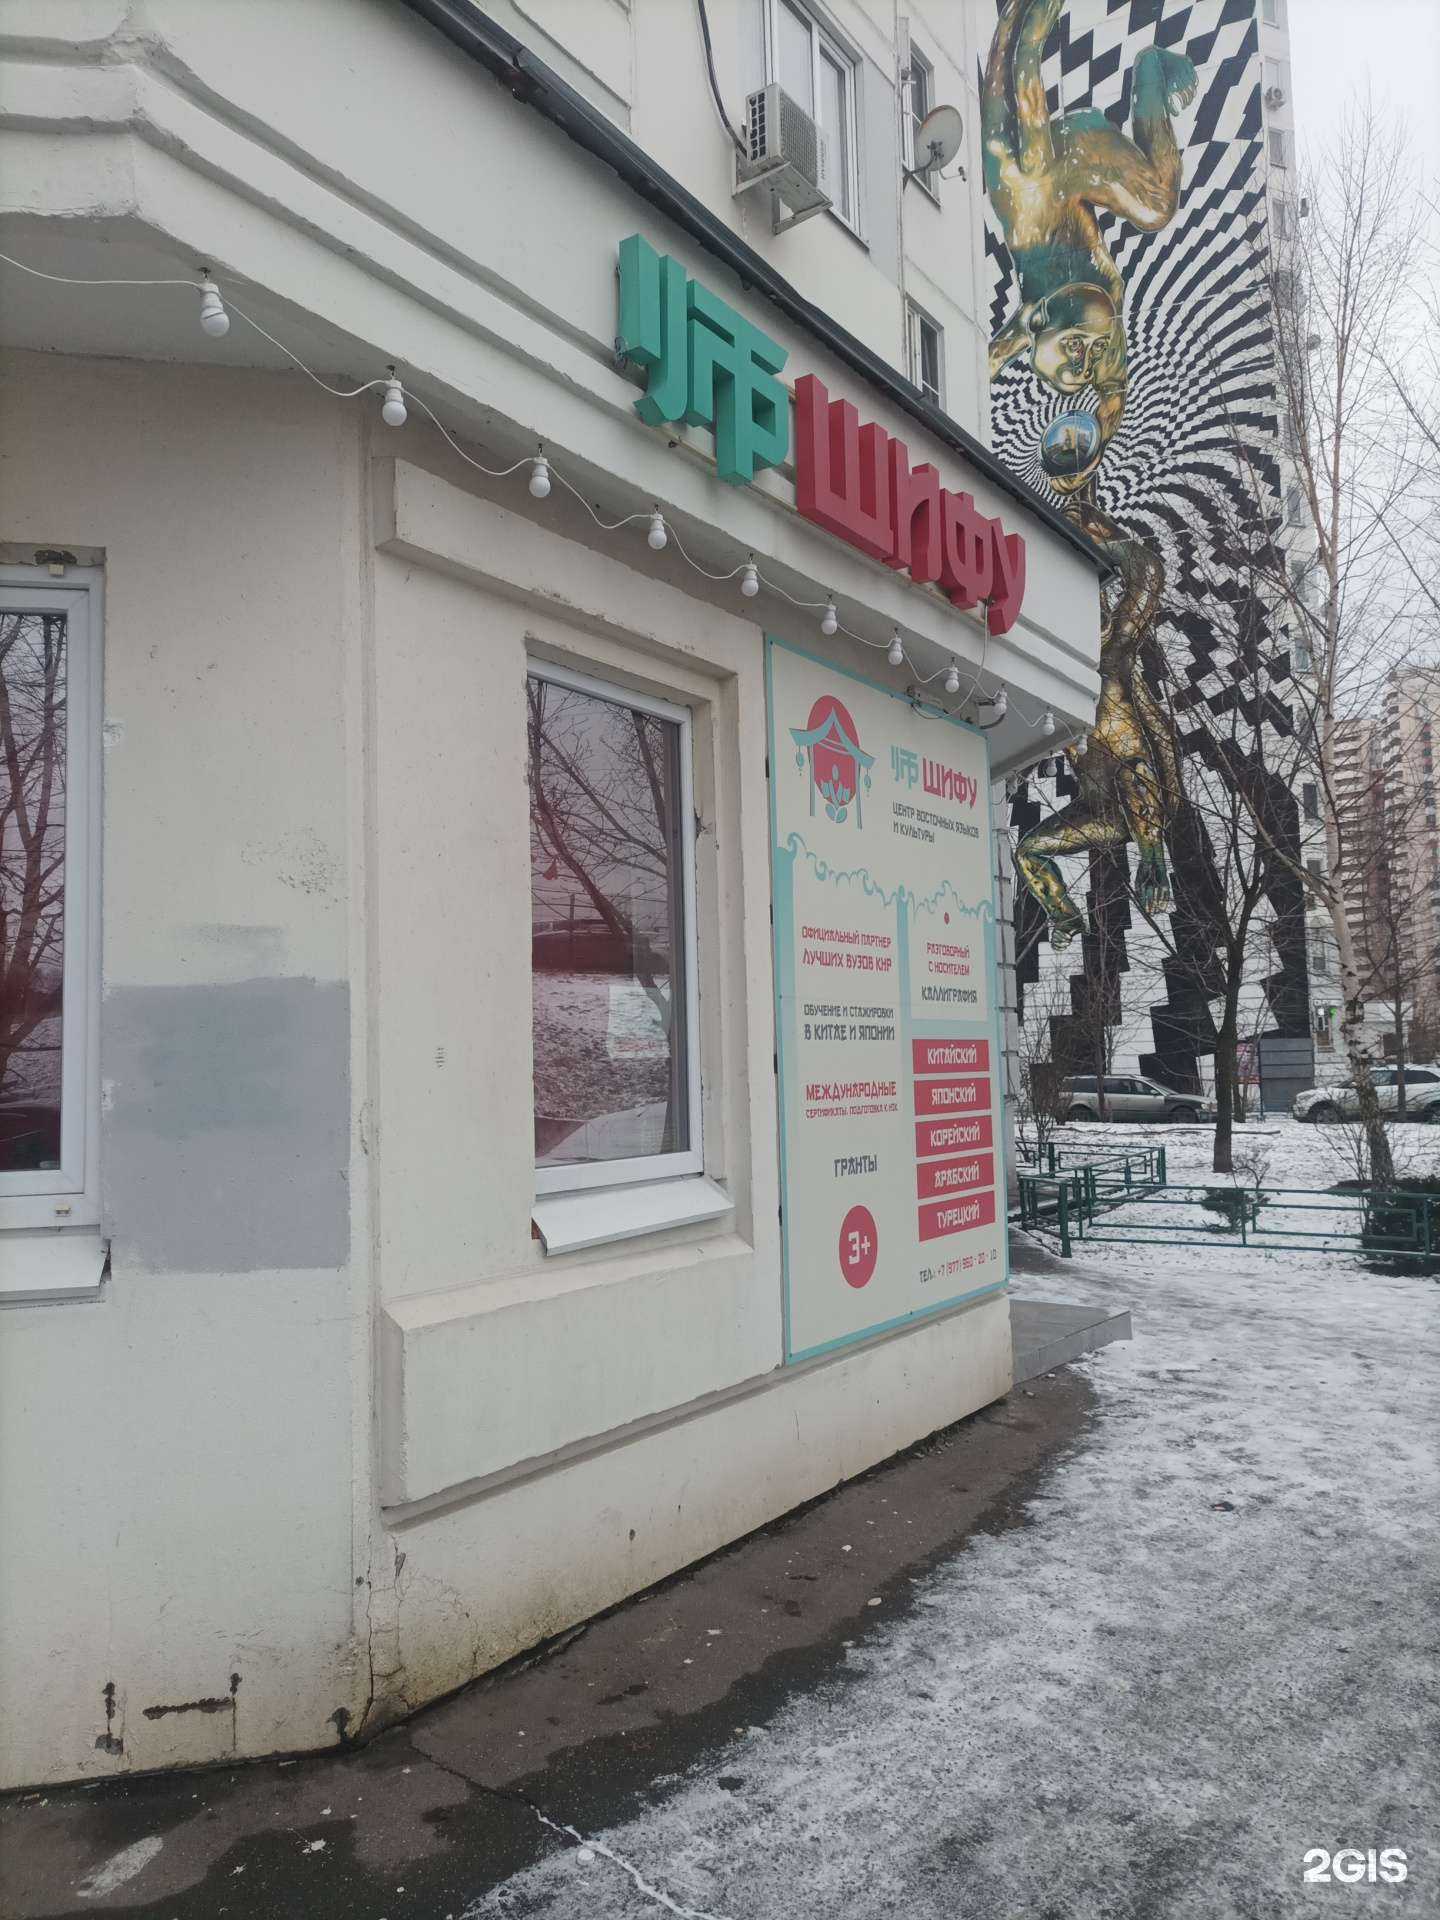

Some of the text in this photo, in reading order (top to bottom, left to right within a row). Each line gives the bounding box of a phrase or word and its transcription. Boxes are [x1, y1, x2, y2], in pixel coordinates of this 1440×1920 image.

[795, 373, 1026, 636] ШИФУ
[923, 757, 977, 809] ШИФУ
[892, 801, 979, 839] ЦЕНТР ВОСТОЧНЫХ ЯЗЫКОВ
[893, 820, 935, 843] И КУЛЬТУРЫ
[802, 925, 892, 949] ОФИЦИАЛЬНЫЙ ПАРТНЕР
[803, 948, 892, 972] ЛУЧШИХ ВУЗОВ КНР
[926, 942, 970, 959] РАЗГОВОРНЫЙ
[928, 961, 970, 977] С НОСИТЕЛЕМ
[921, 985, 978, 1004] КАЛЛИГРАФИЯ
[804, 1004, 894, 1019] ОБУЧЕНИЕ И СТАЖИРОВКИ
[804, 1023, 895, 1041] В КИТАЕ И ЯПОНИИ
[927, 1043, 977, 1065] КИТАЙСКИЙ
[806, 1080, 897, 1102] МЕЖДУНАРОДНЫЕ
[931, 1082, 976, 1105] ЯПОНСКИЙ
[849, 1103, 883, 1116] ПОДГОТОВКА
[930, 1121, 981, 1147] КОРЕЙСКИЙ
[834, 1155, 878, 1177] ГРАНТЫ
[934, 1160, 980, 1188] АРАБСКИЙ
[937, 1199, 980, 1229] ТУРЕЦКИЙ
[848, 1231, 871, 1265] 3+
